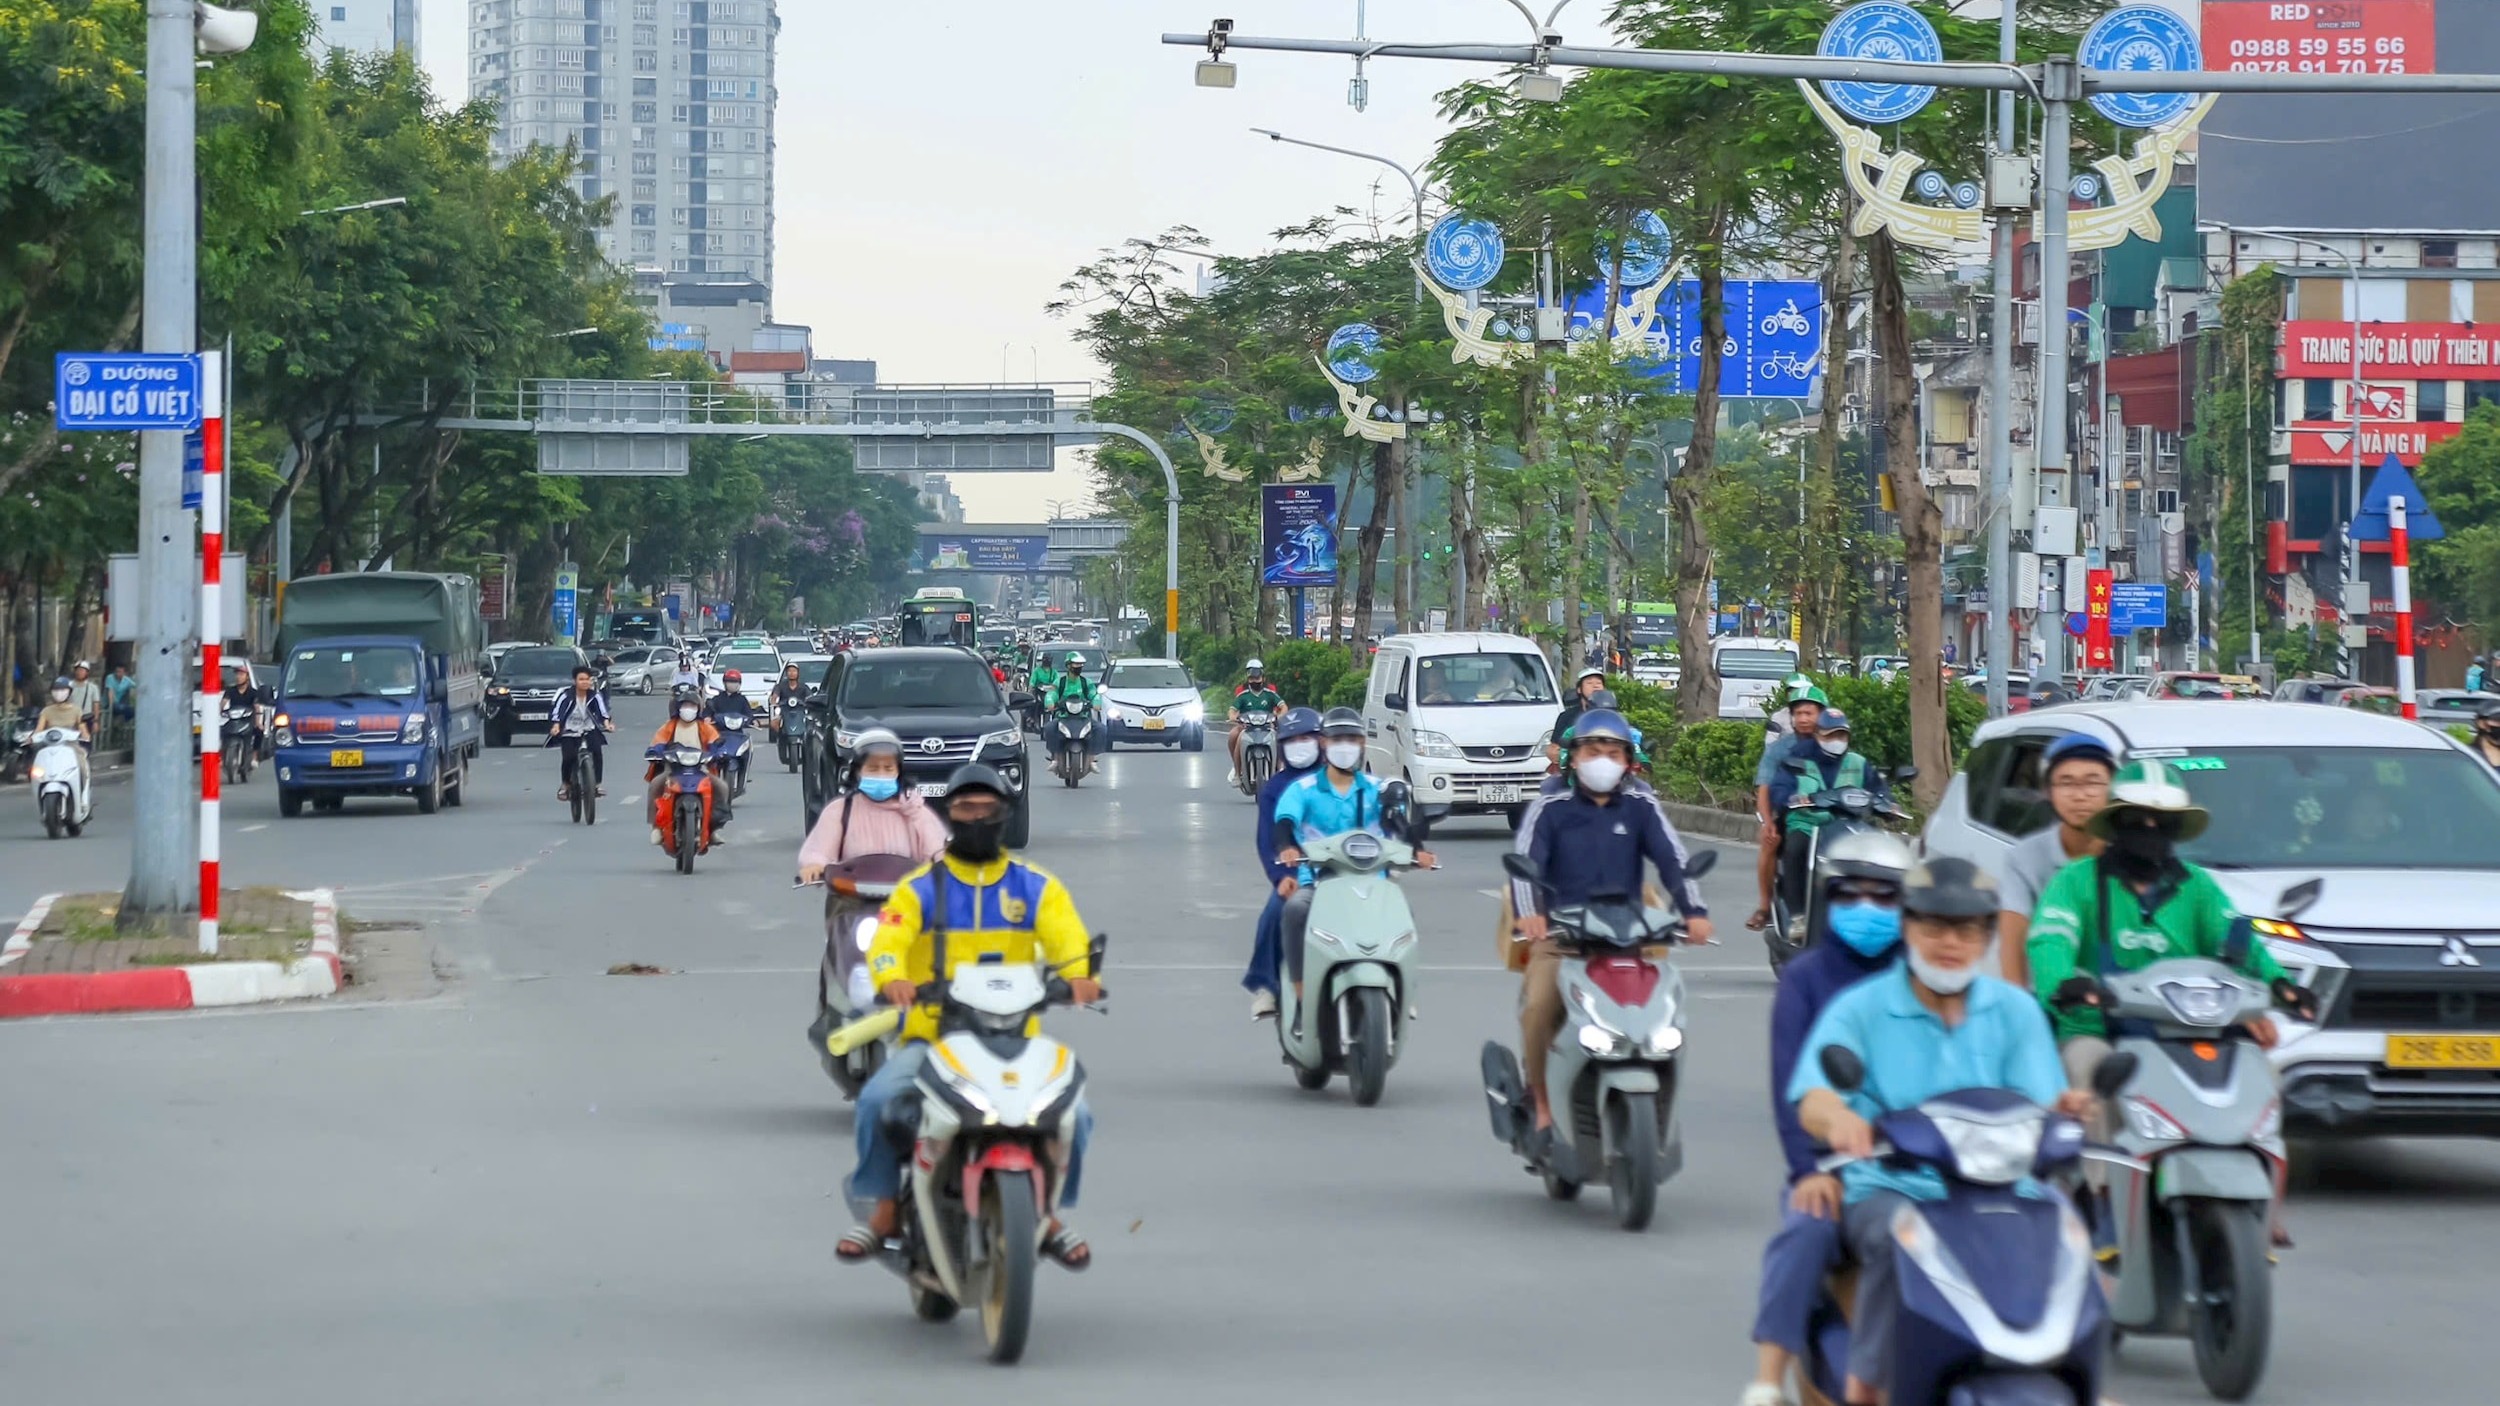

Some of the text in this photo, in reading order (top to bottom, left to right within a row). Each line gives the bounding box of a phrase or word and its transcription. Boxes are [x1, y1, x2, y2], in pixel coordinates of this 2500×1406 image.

[2270, 4, 2310, 21] RED
[2230, 37, 2405, 57] 0988 59 55 66
[2230, 59, 2405, 74] 0978 91 70 75
[2301, 336, 2350, 363] TRANG
[2412, 333, 2440, 367] QUÝ
[2446, 333, 2488, 365] THIÊN
[102, 364, 178, 381] ĐƯỜNG
[70, 390, 106, 420] ĐẠI
[145, 386, 190, 421] VIỆT
[2361, 430, 2409, 454] VÀNG
